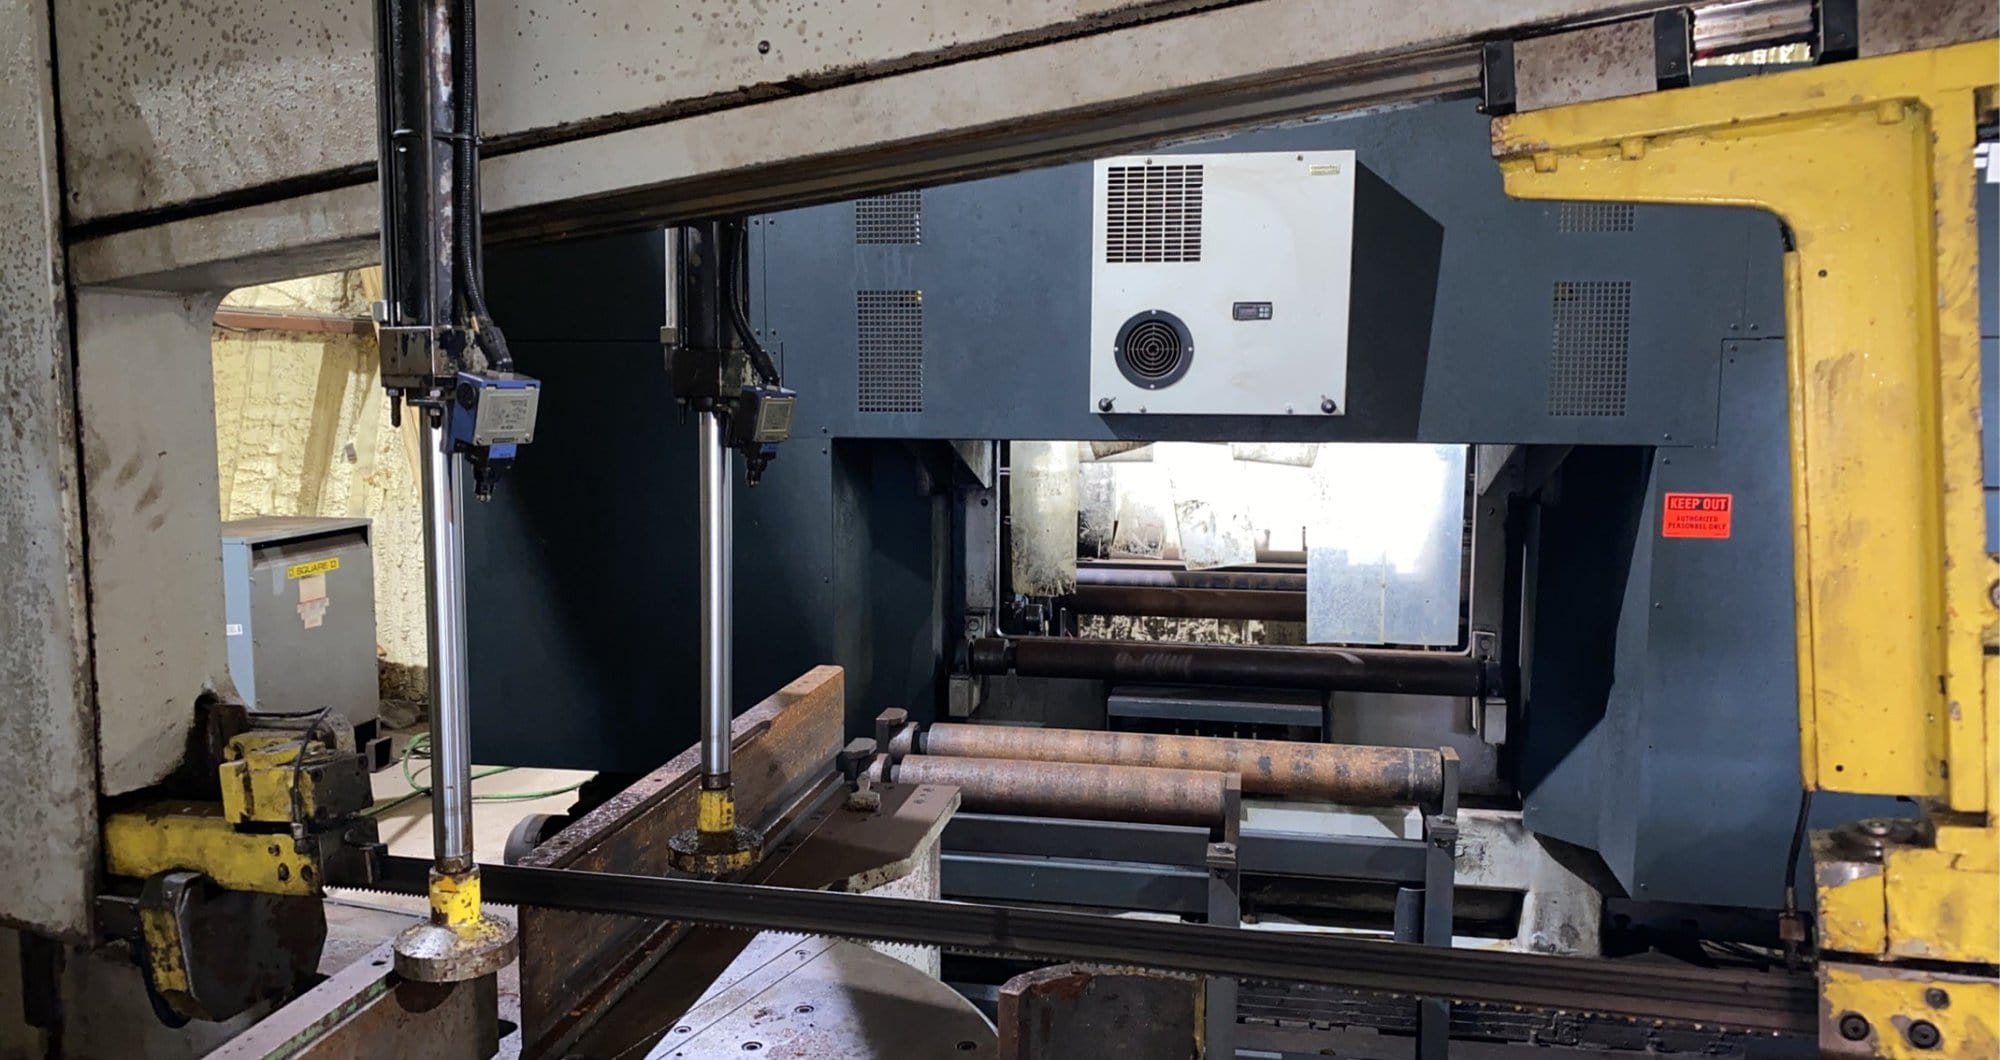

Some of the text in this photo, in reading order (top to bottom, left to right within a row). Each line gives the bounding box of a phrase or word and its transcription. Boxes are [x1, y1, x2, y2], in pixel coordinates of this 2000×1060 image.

[1670, 498, 1726, 510] KEEP OUT
[296, 562, 328, 575] SQUARE
